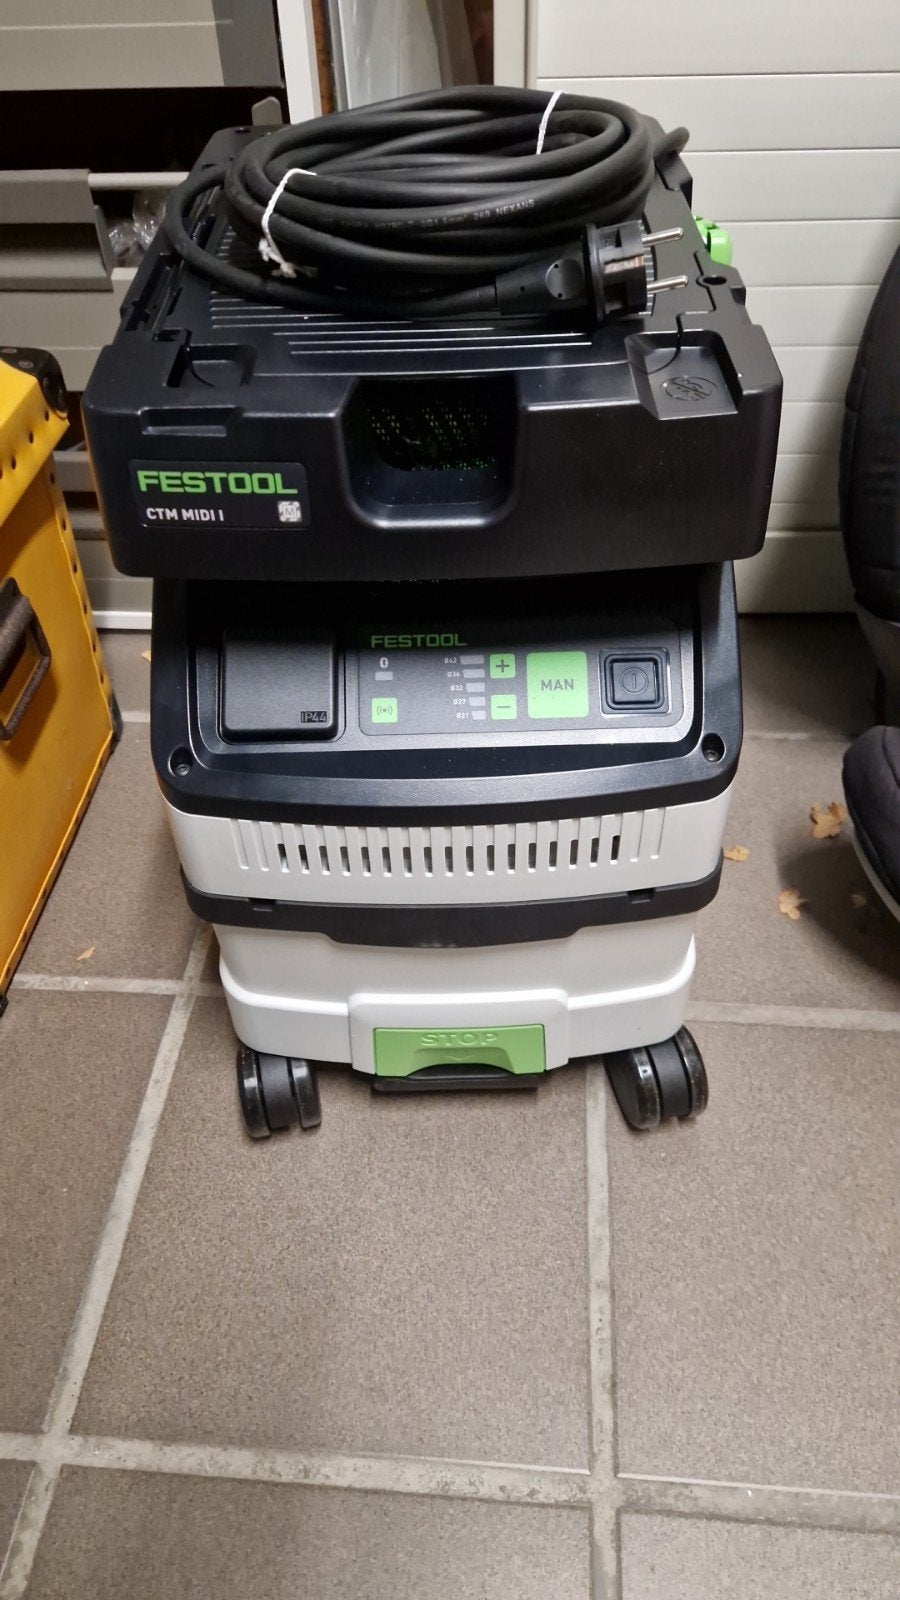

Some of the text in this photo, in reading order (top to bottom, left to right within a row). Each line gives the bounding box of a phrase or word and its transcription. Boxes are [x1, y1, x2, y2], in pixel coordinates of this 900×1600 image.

[495, 199, 536, 217] NEXANS
[136, 470, 299, 494] FESTOOL
[146, 507, 179, 521] CTM
[181, 508, 216, 522] MIDI
[370, 633, 468, 649] FESTOOL
[540, 678, 575, 692] MAN
[301, 710, 328, 724] IP44
[420, 1032, 499, 1046] STOP
